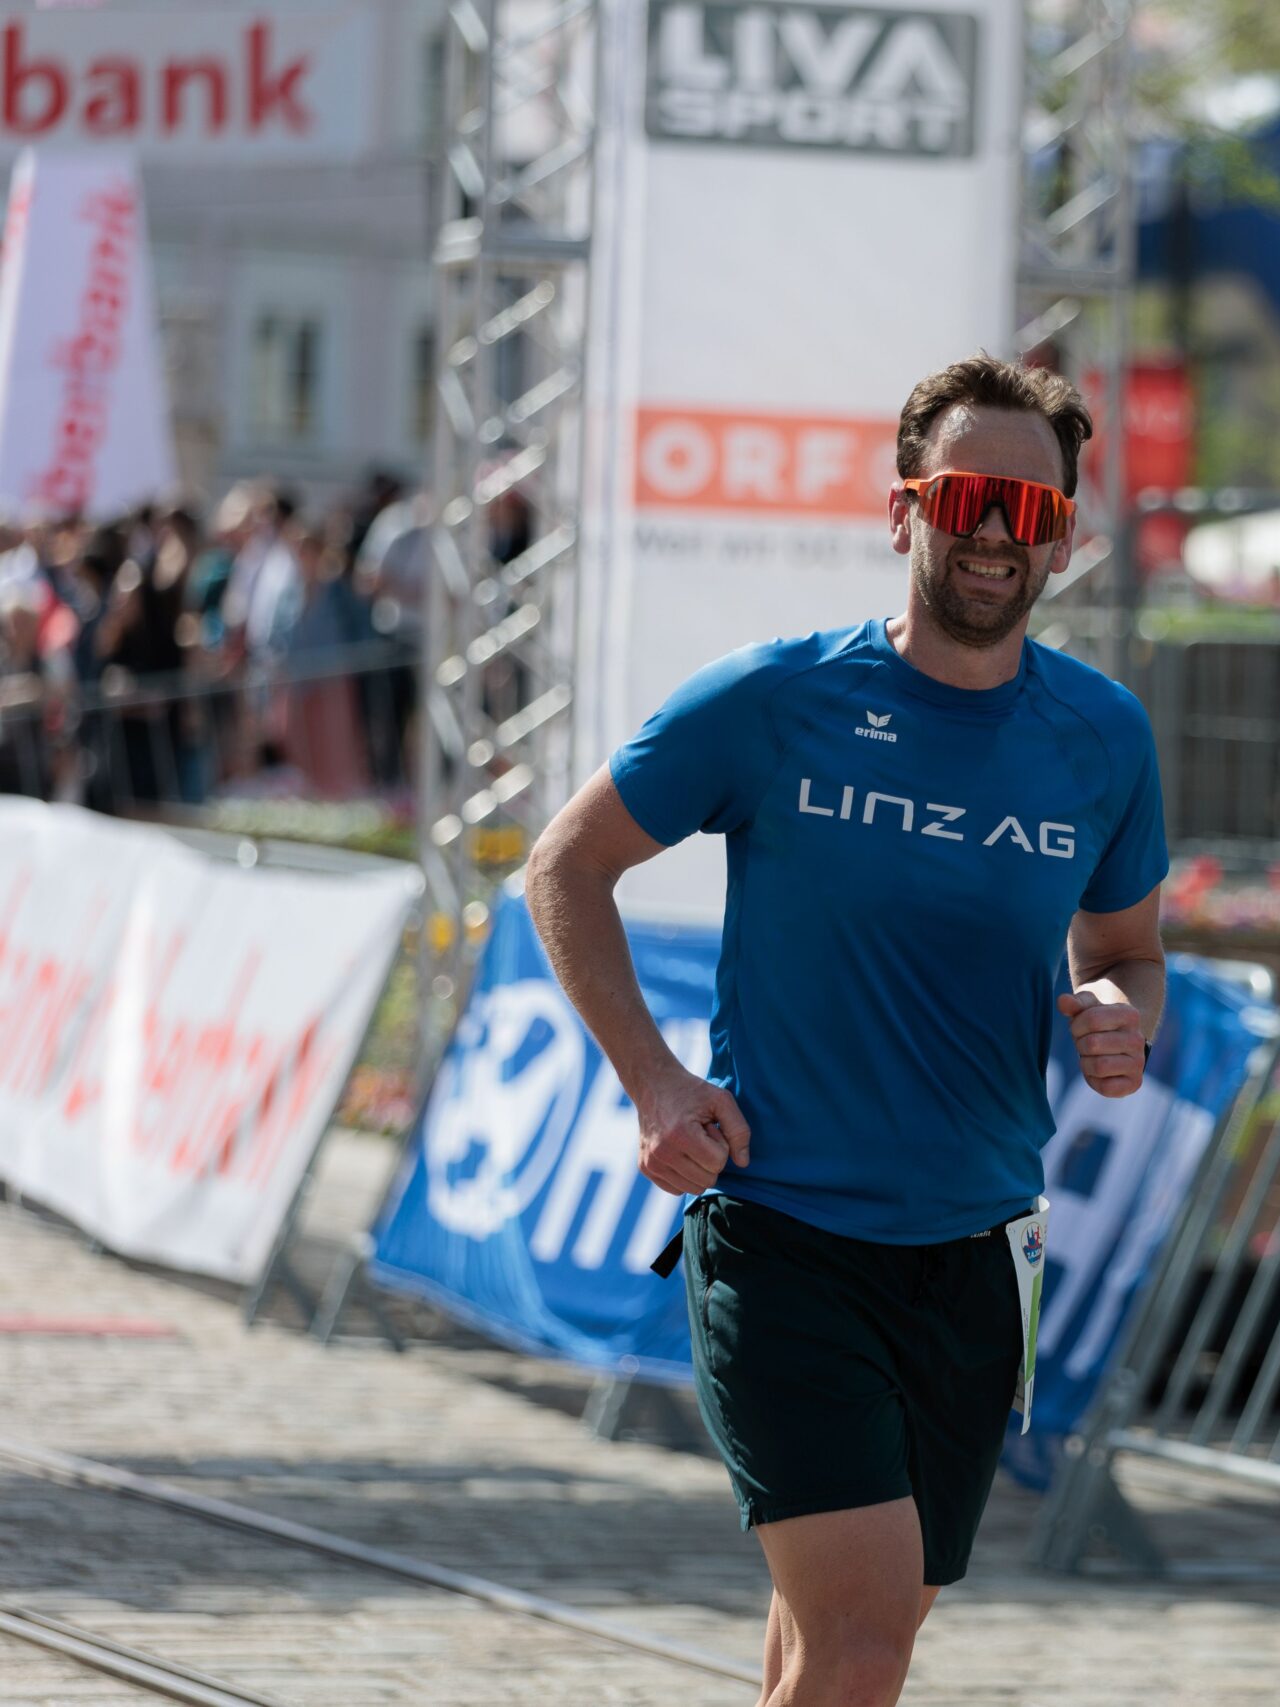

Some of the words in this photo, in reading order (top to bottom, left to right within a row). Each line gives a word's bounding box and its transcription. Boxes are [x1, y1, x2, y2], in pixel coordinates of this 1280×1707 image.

[0, 20, 312, 136] bank
[660, 4, 968, 100] LIVA
[660, 90, 964, 148] SPORT
[640, 416, 858, 502] ORF
[855, 727, 897, 743] erima
[799, 778, 966, 841] LINZ
[982, 816, 1075, 859] AG
